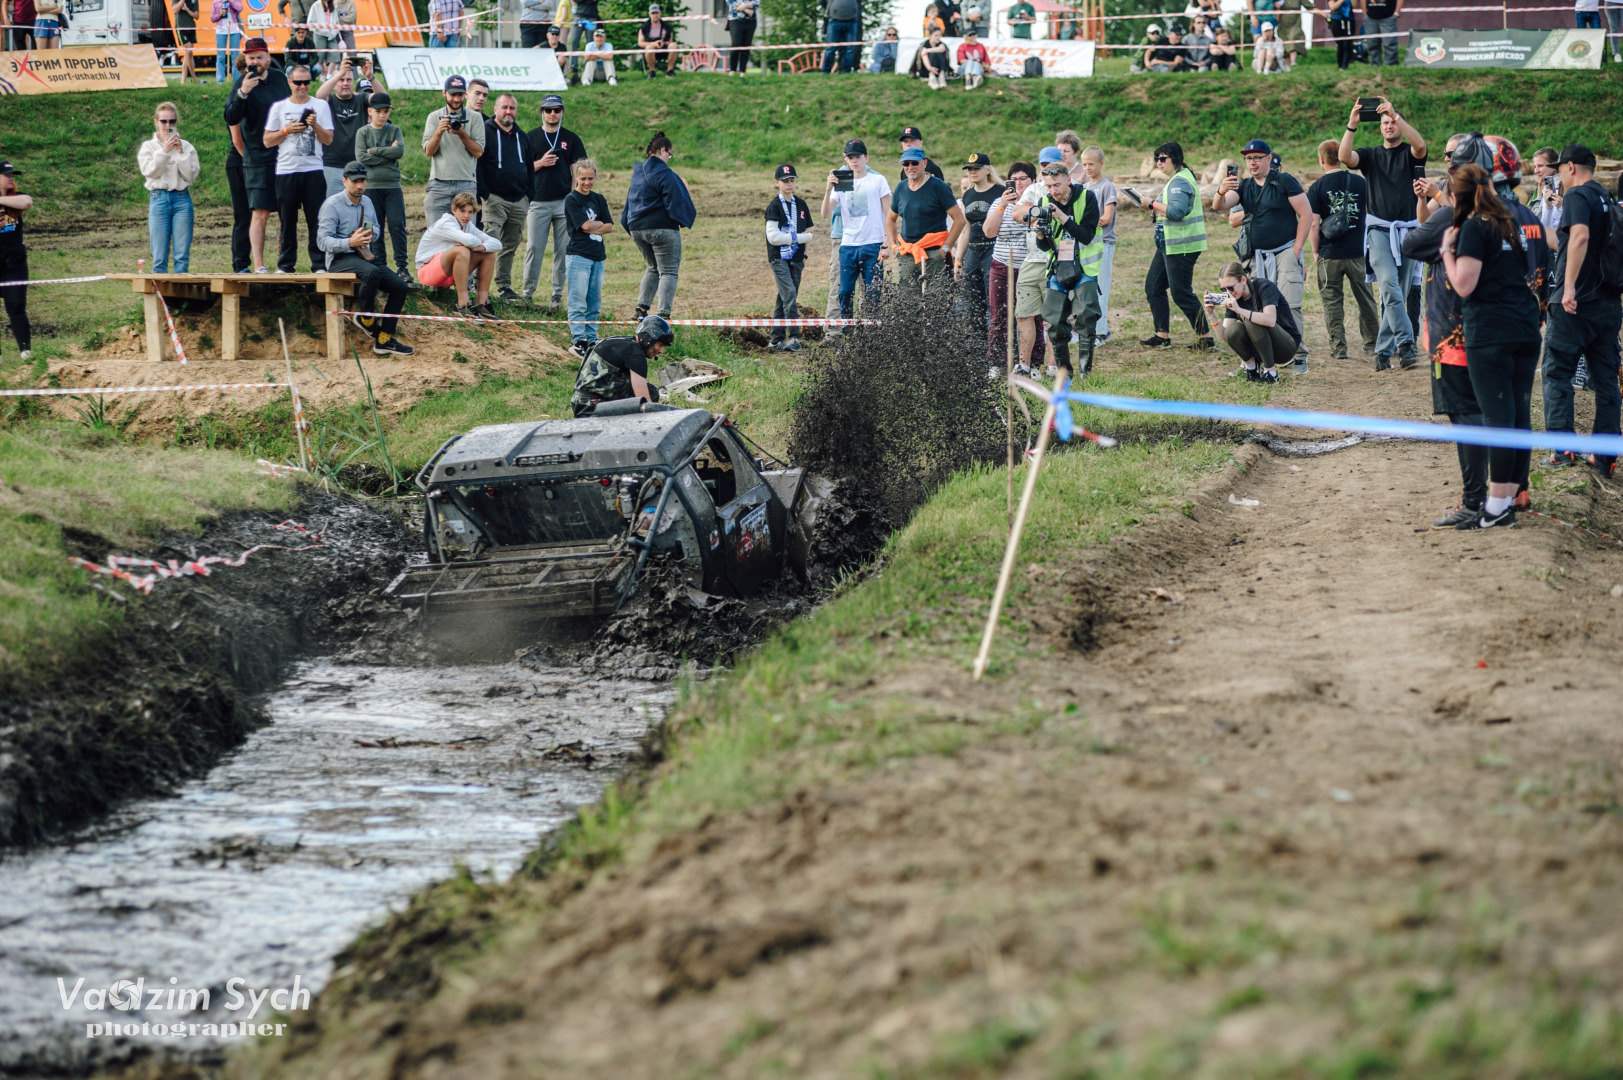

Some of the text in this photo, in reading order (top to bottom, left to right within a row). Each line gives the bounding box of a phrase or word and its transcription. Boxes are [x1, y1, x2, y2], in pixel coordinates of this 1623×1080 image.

[1453, 52, 1494, 61] УШАЧСКИЙ
[64, 57, 118, 69] ПРОРЫВ
[47, 71, 120, 82] sport-ushachi.by
[439, 64, 531, 78] мирамет
